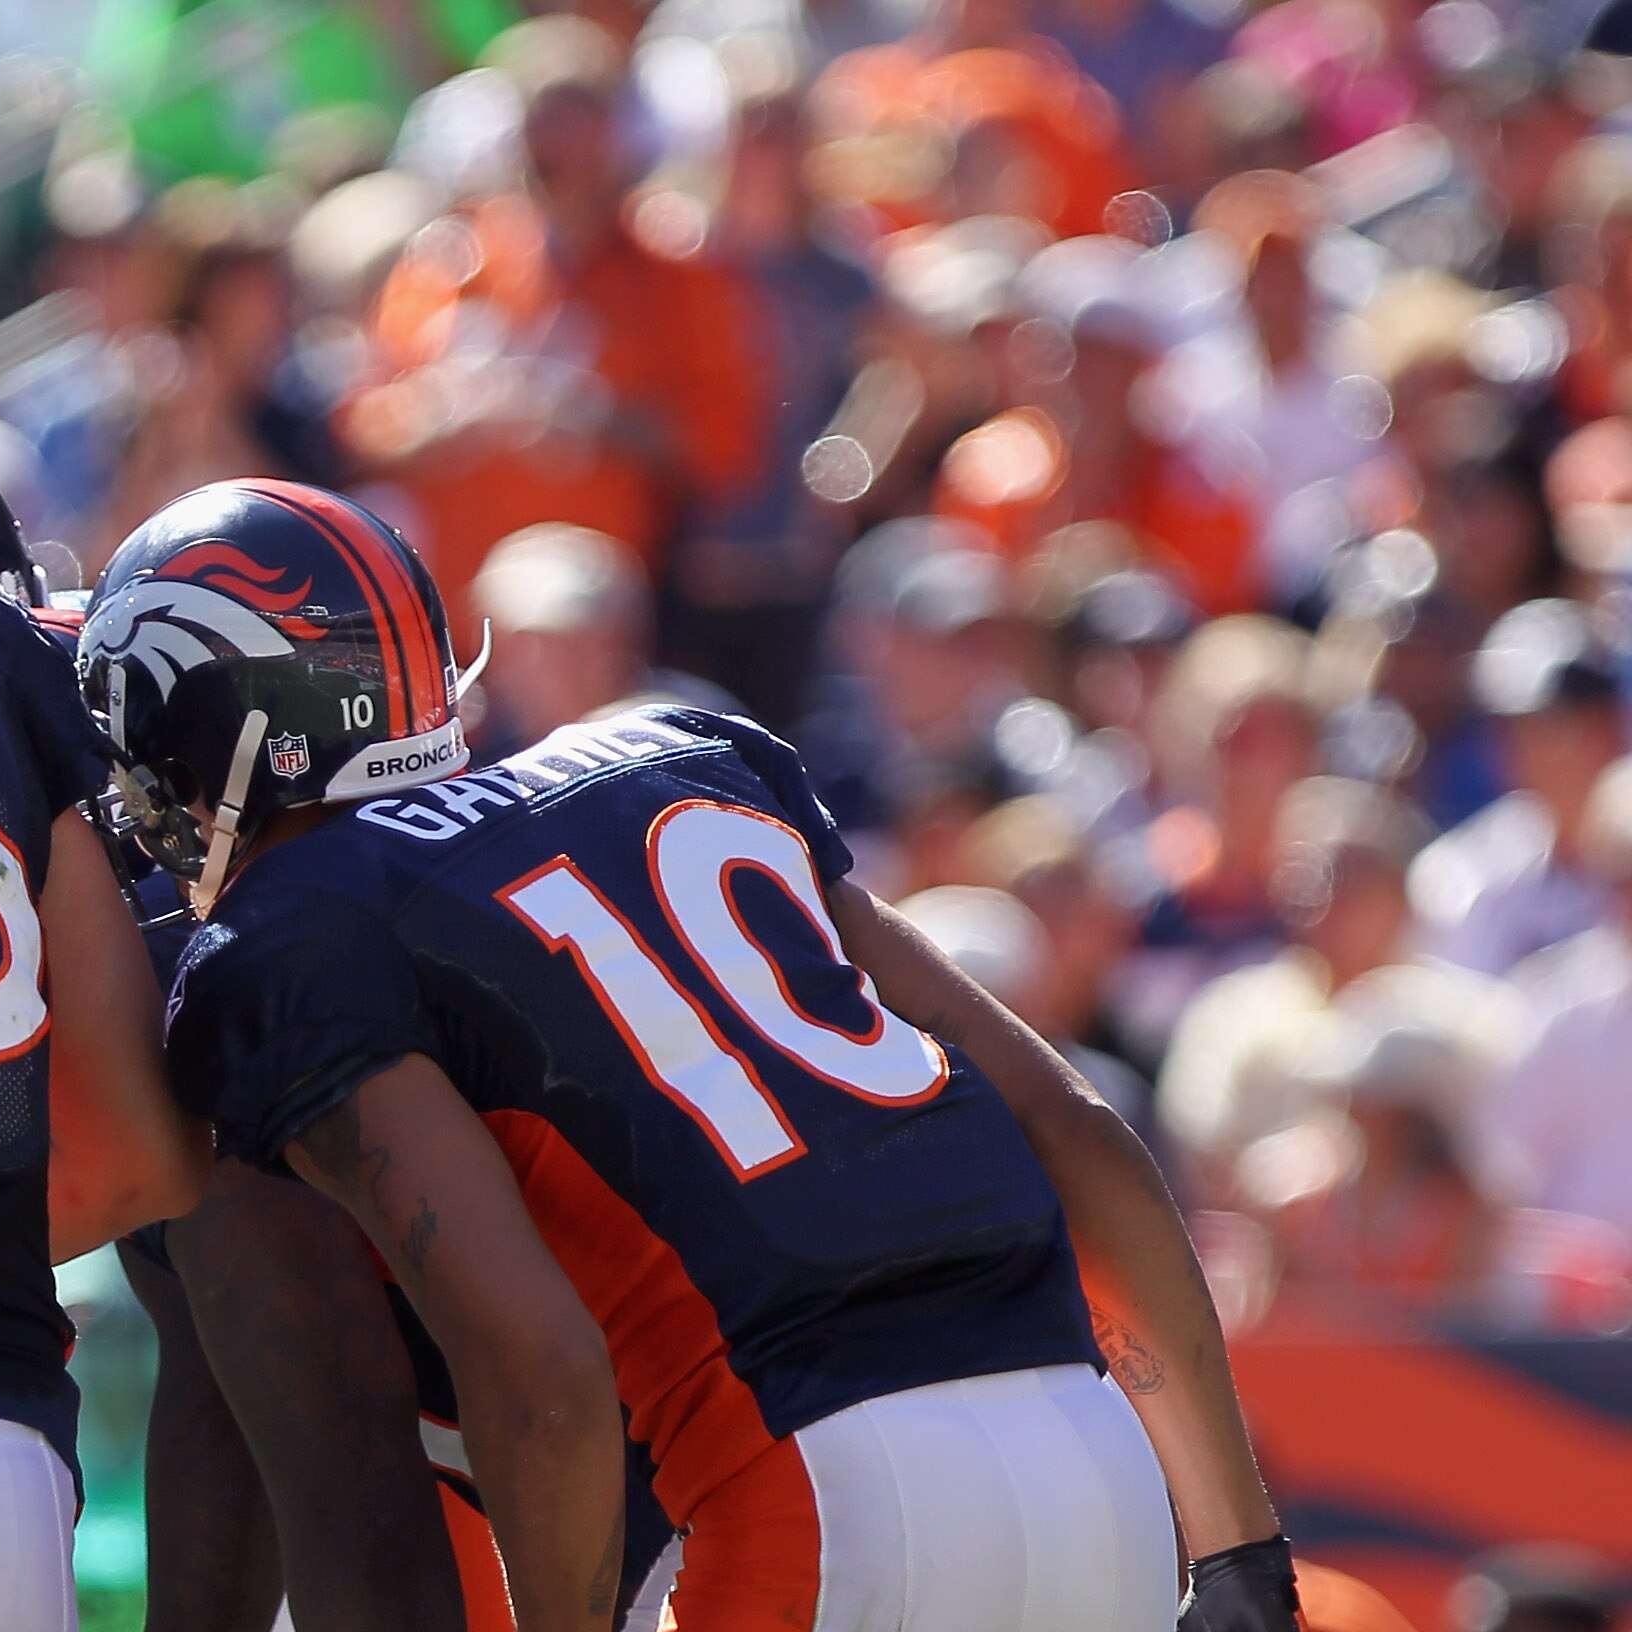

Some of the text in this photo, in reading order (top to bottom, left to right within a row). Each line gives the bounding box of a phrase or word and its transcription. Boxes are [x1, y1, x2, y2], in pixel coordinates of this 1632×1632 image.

[340, 694, 375, 731] 10
[275, 750, 306, 773] NFL
[492, 797, 952, 1184] 10
